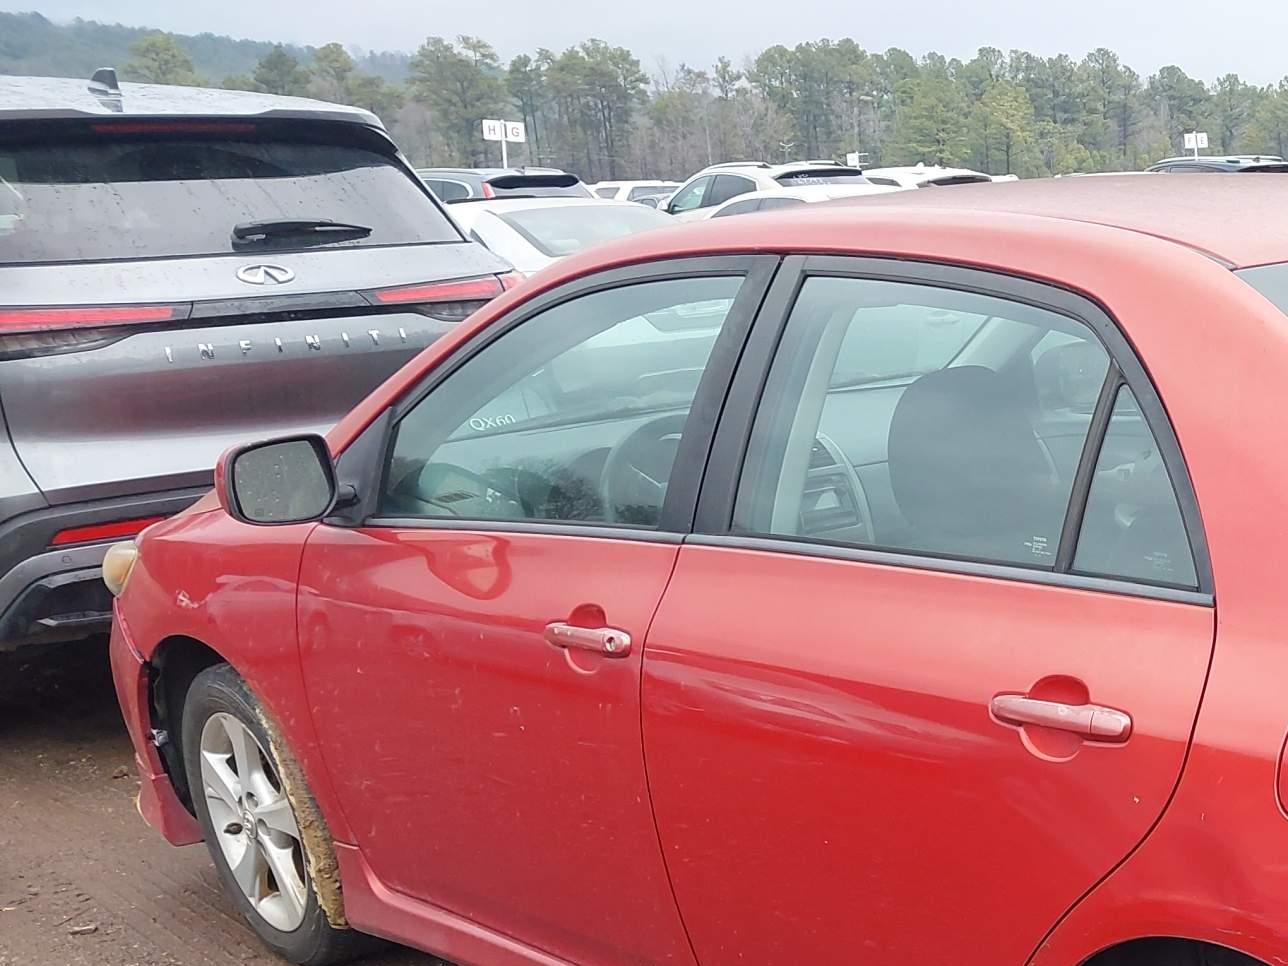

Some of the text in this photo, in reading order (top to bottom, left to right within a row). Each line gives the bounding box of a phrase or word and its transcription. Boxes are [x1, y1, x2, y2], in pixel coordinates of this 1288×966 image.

[487, 125, 496, 136] H
[511, 127, 520, 137] G
[164, 327, 407, 363] INFINITI
